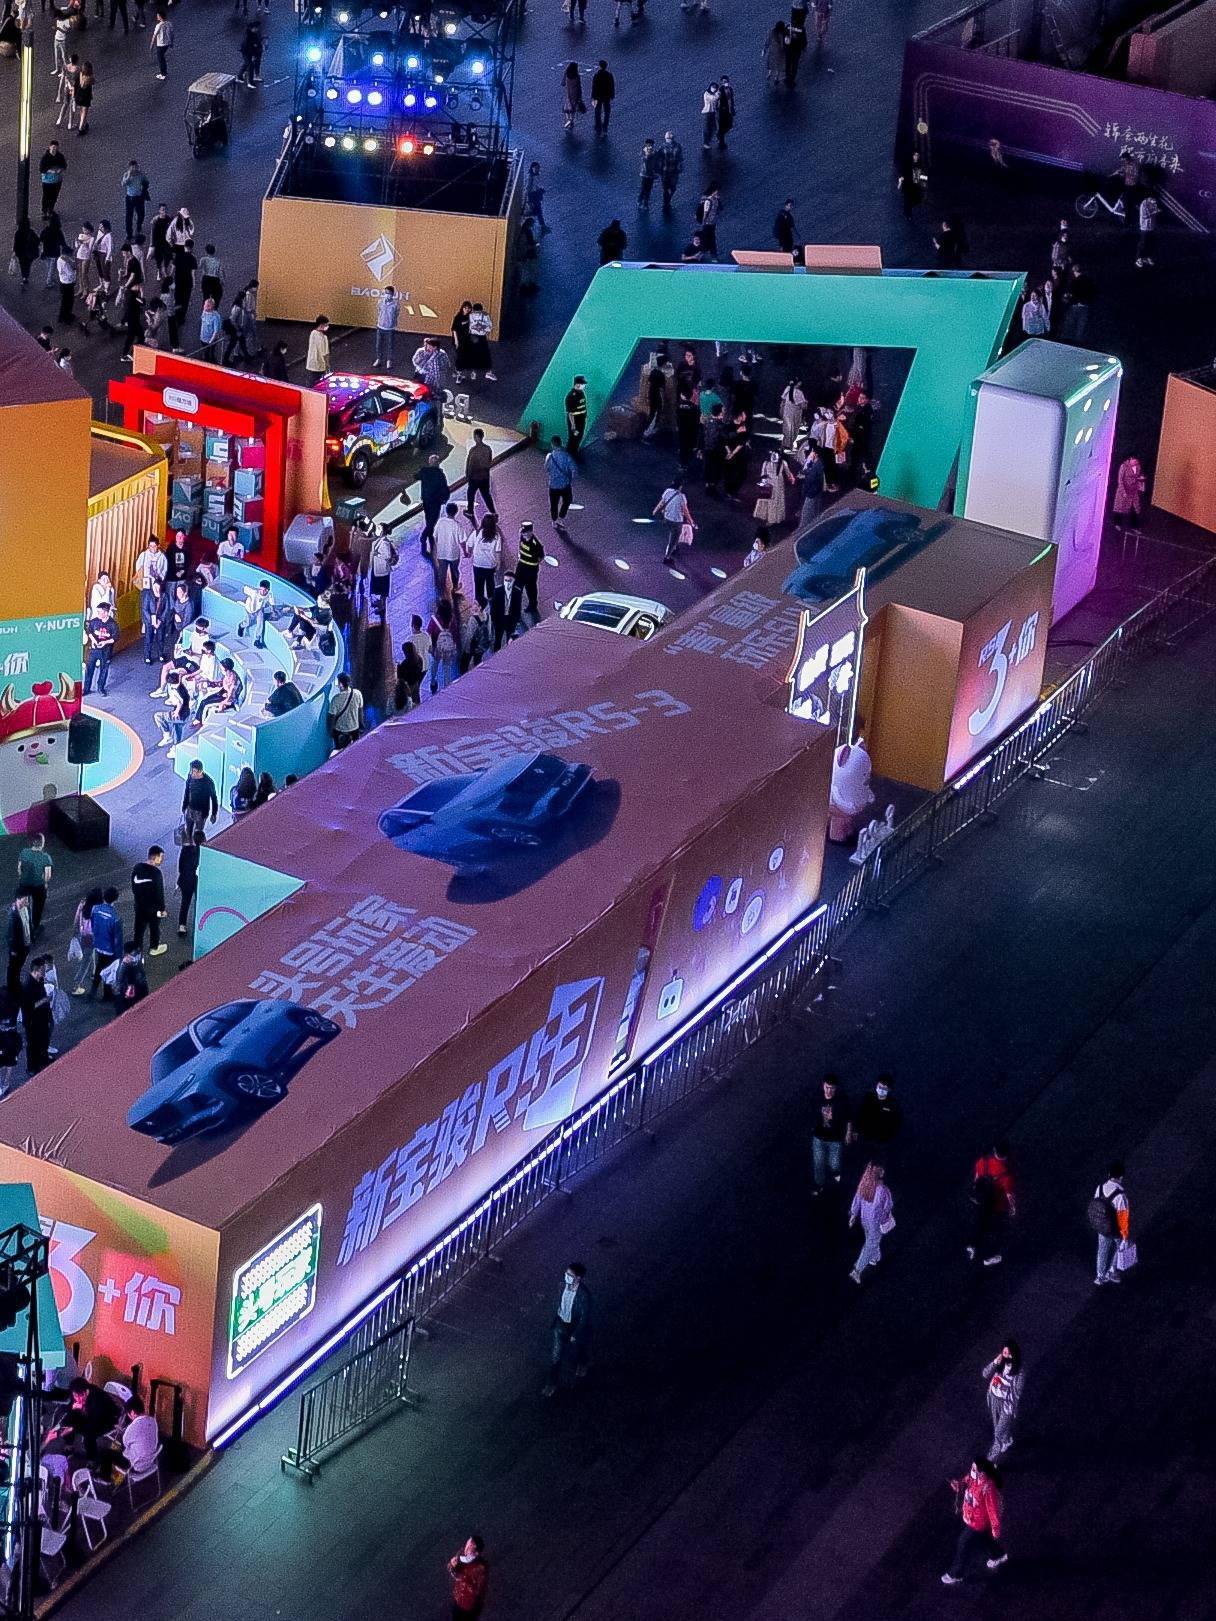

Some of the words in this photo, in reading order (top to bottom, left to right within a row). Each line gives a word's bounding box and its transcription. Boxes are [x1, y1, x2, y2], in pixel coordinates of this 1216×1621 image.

[351, 286, 411, 302] BAOUN
[247, 894, 419, 1003] 头号玩家
[306, 915, 479, 1030] 天生爱动
